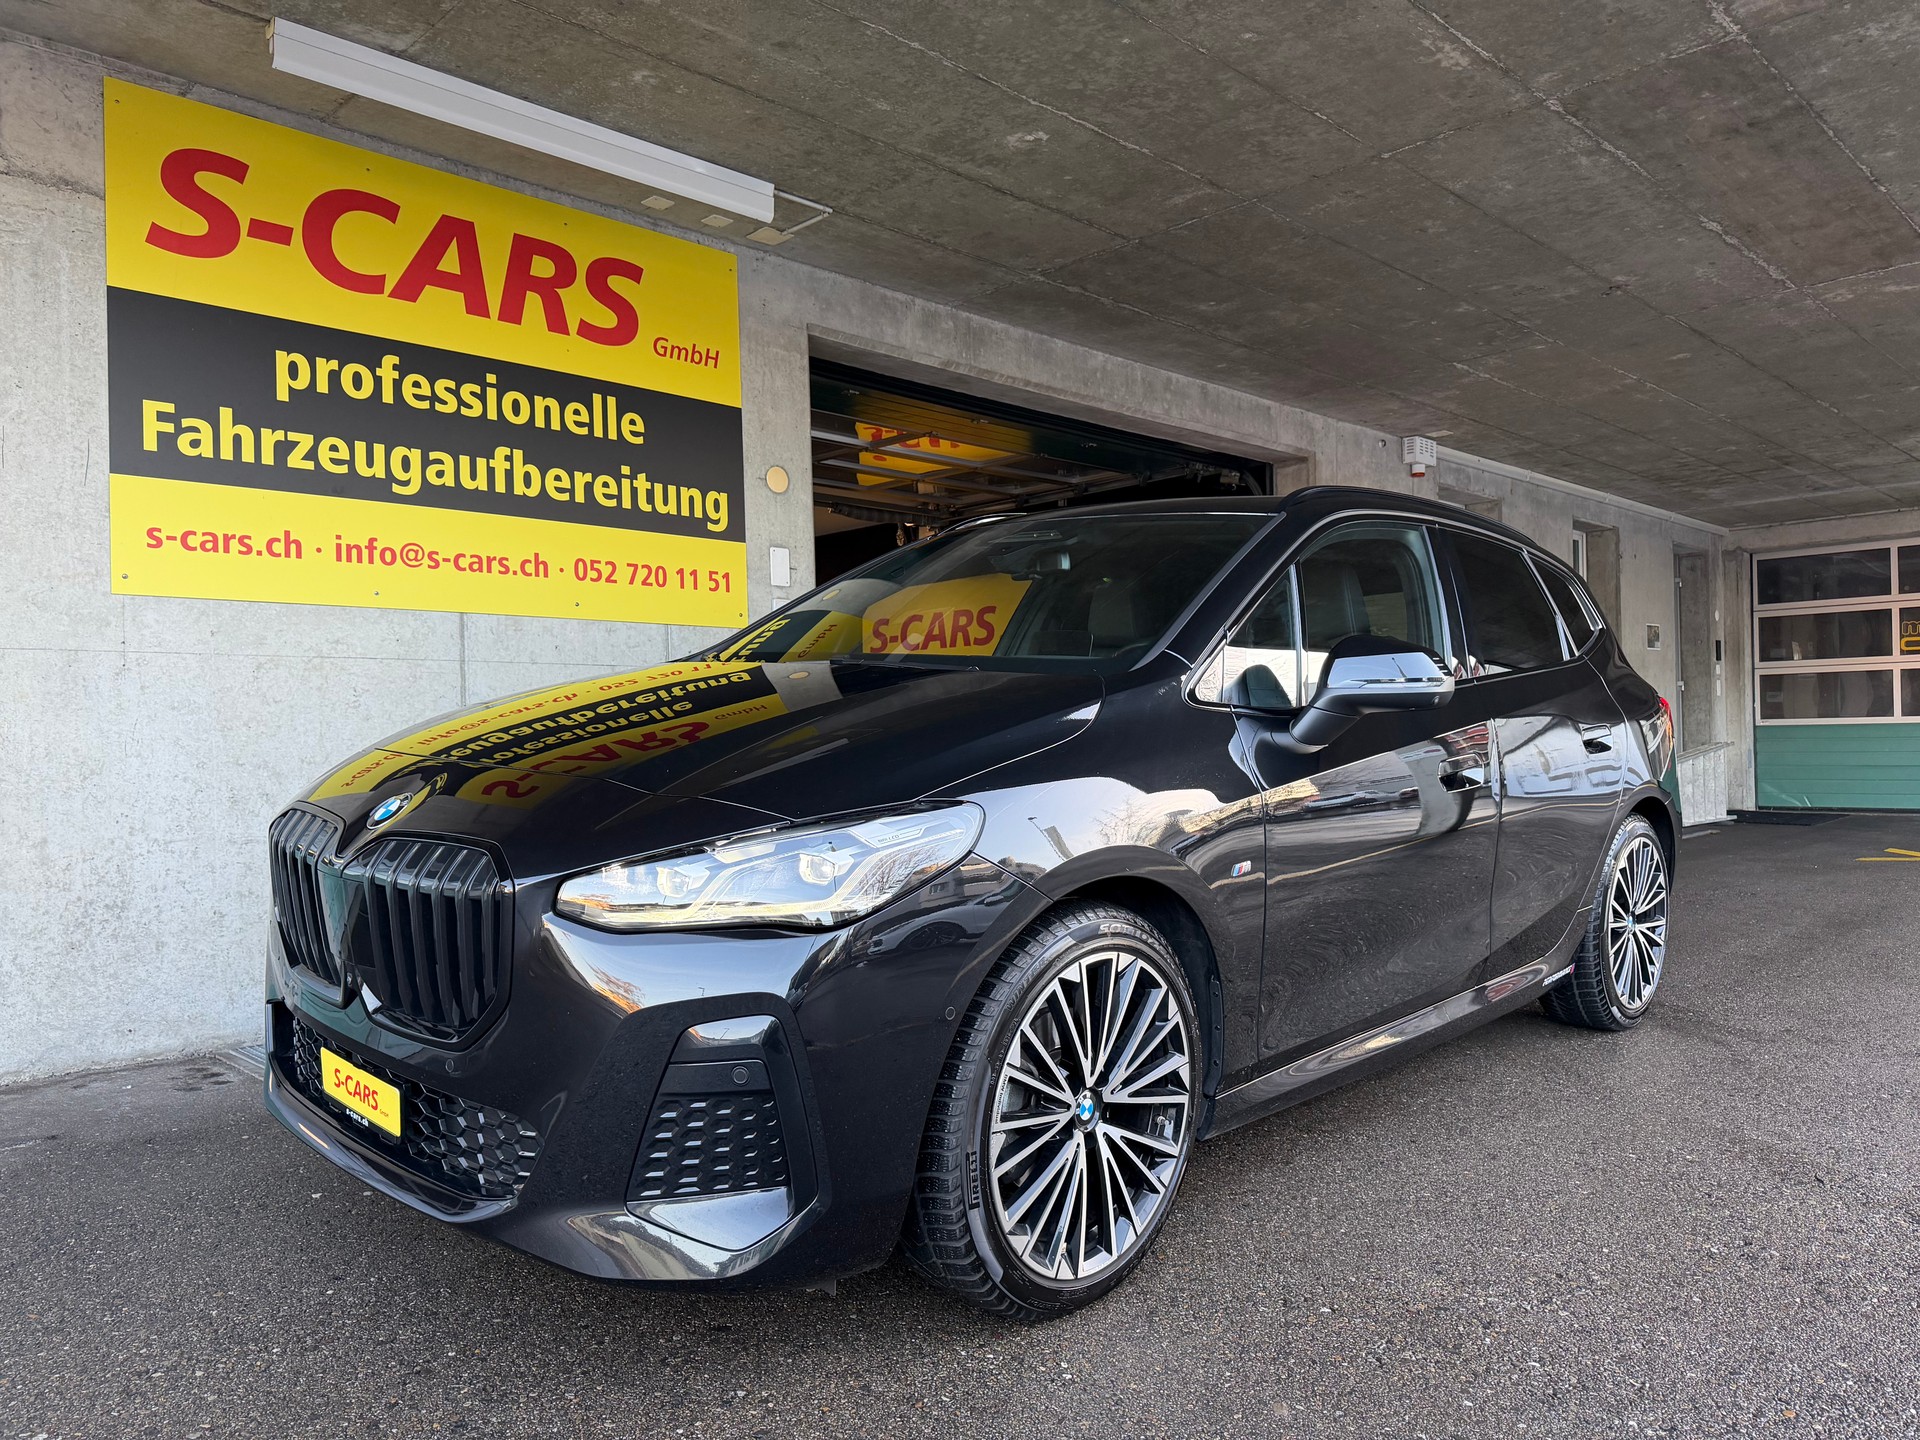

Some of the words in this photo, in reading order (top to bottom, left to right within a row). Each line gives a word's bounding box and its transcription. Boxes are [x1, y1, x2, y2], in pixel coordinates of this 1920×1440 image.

[144, 147, 644, 347] S-CARS
[652, 336, 720, 370] GmbH
[274, 349, 645, 446] professionelle
[141, 398, 730, 533] Fahrzeugaufbereitung
[145, 524, 303, 561] s-cars.ch
[334, 534, 550, 581] info@s-cars.ch
[573, 556, 617, 587] 052
[626, 562, 667, 590] 720
[674, 567, 699, 592] 11
[707, 570, 732, 594] 51
[870, 605, 997, 653] S-CARS
[333, 1067, 379, 1111] S-CARS
